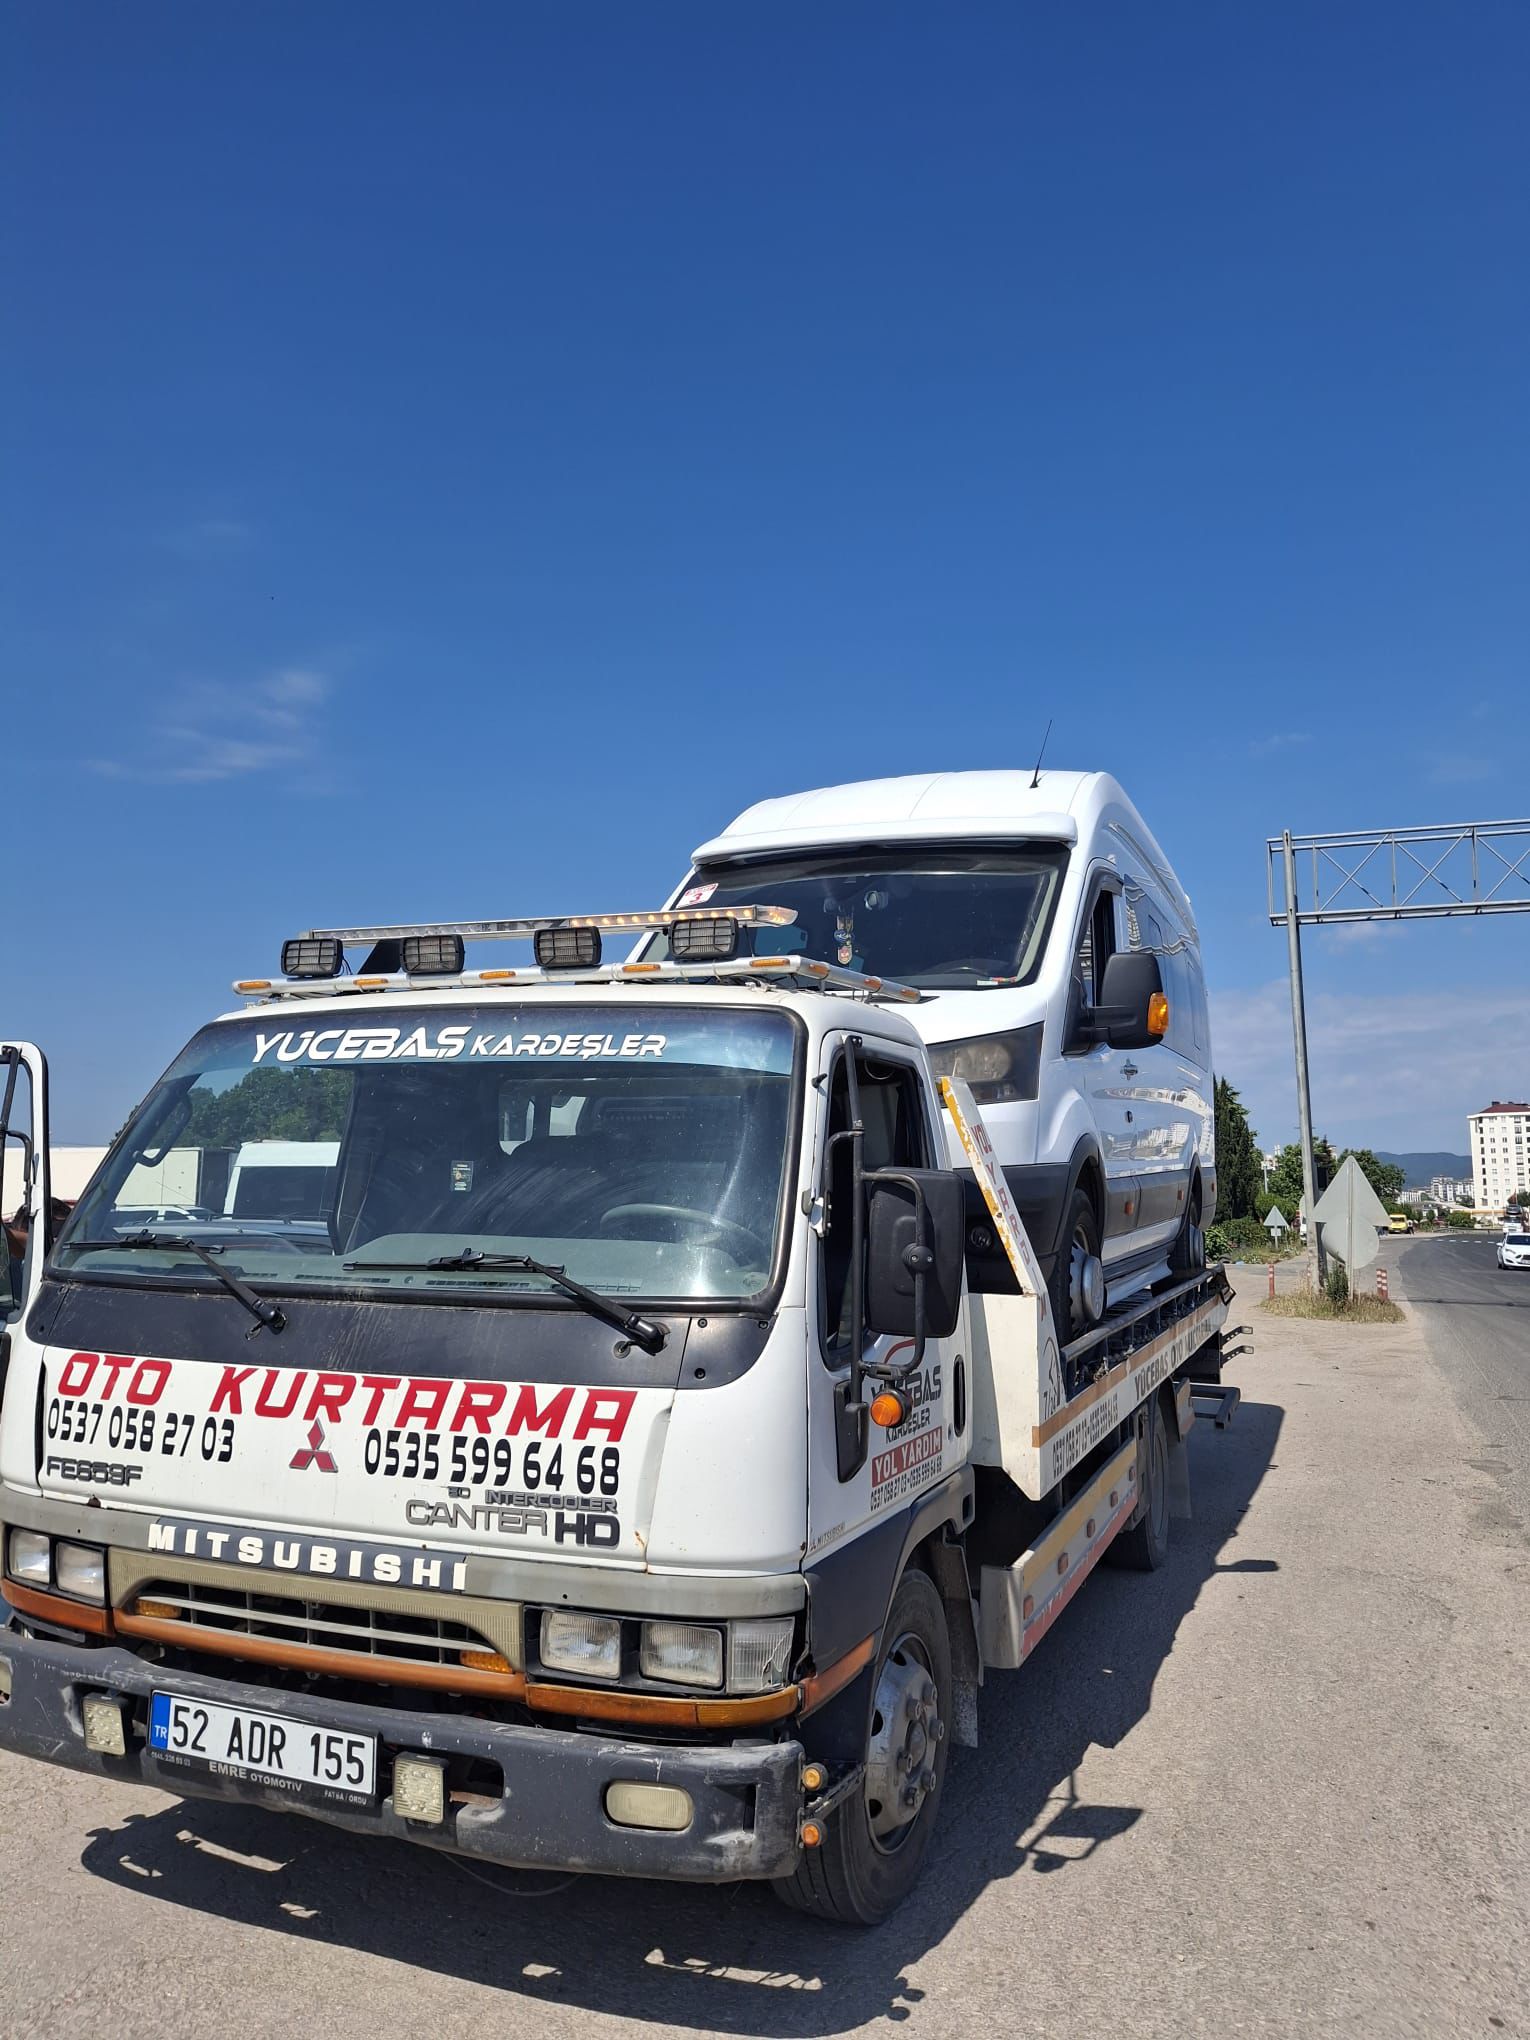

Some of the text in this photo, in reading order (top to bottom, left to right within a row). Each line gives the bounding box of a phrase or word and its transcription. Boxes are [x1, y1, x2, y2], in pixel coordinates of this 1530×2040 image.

[470, 1034, 668, 1060] KARDEŞLER
[58, 1353, 638, 1442] OTO KURTARMA
[48, 1398, 235, 1463] 0537 058 27 03
[875, 1431, 941, 1482] YOL YARDIM
[364, 1428, 620, 1495] 0535 599 64 68
[405, 1499, 620, 1549] CANTER HD
[485, 1489, 619, 1514] INTERCOOLER
[148, 1523, 468, 1591] MITSUBISHI
[155, 1705, 365, 1784] TR 52 ADR 155
[209, 1761, 247, 1779] EMRE
